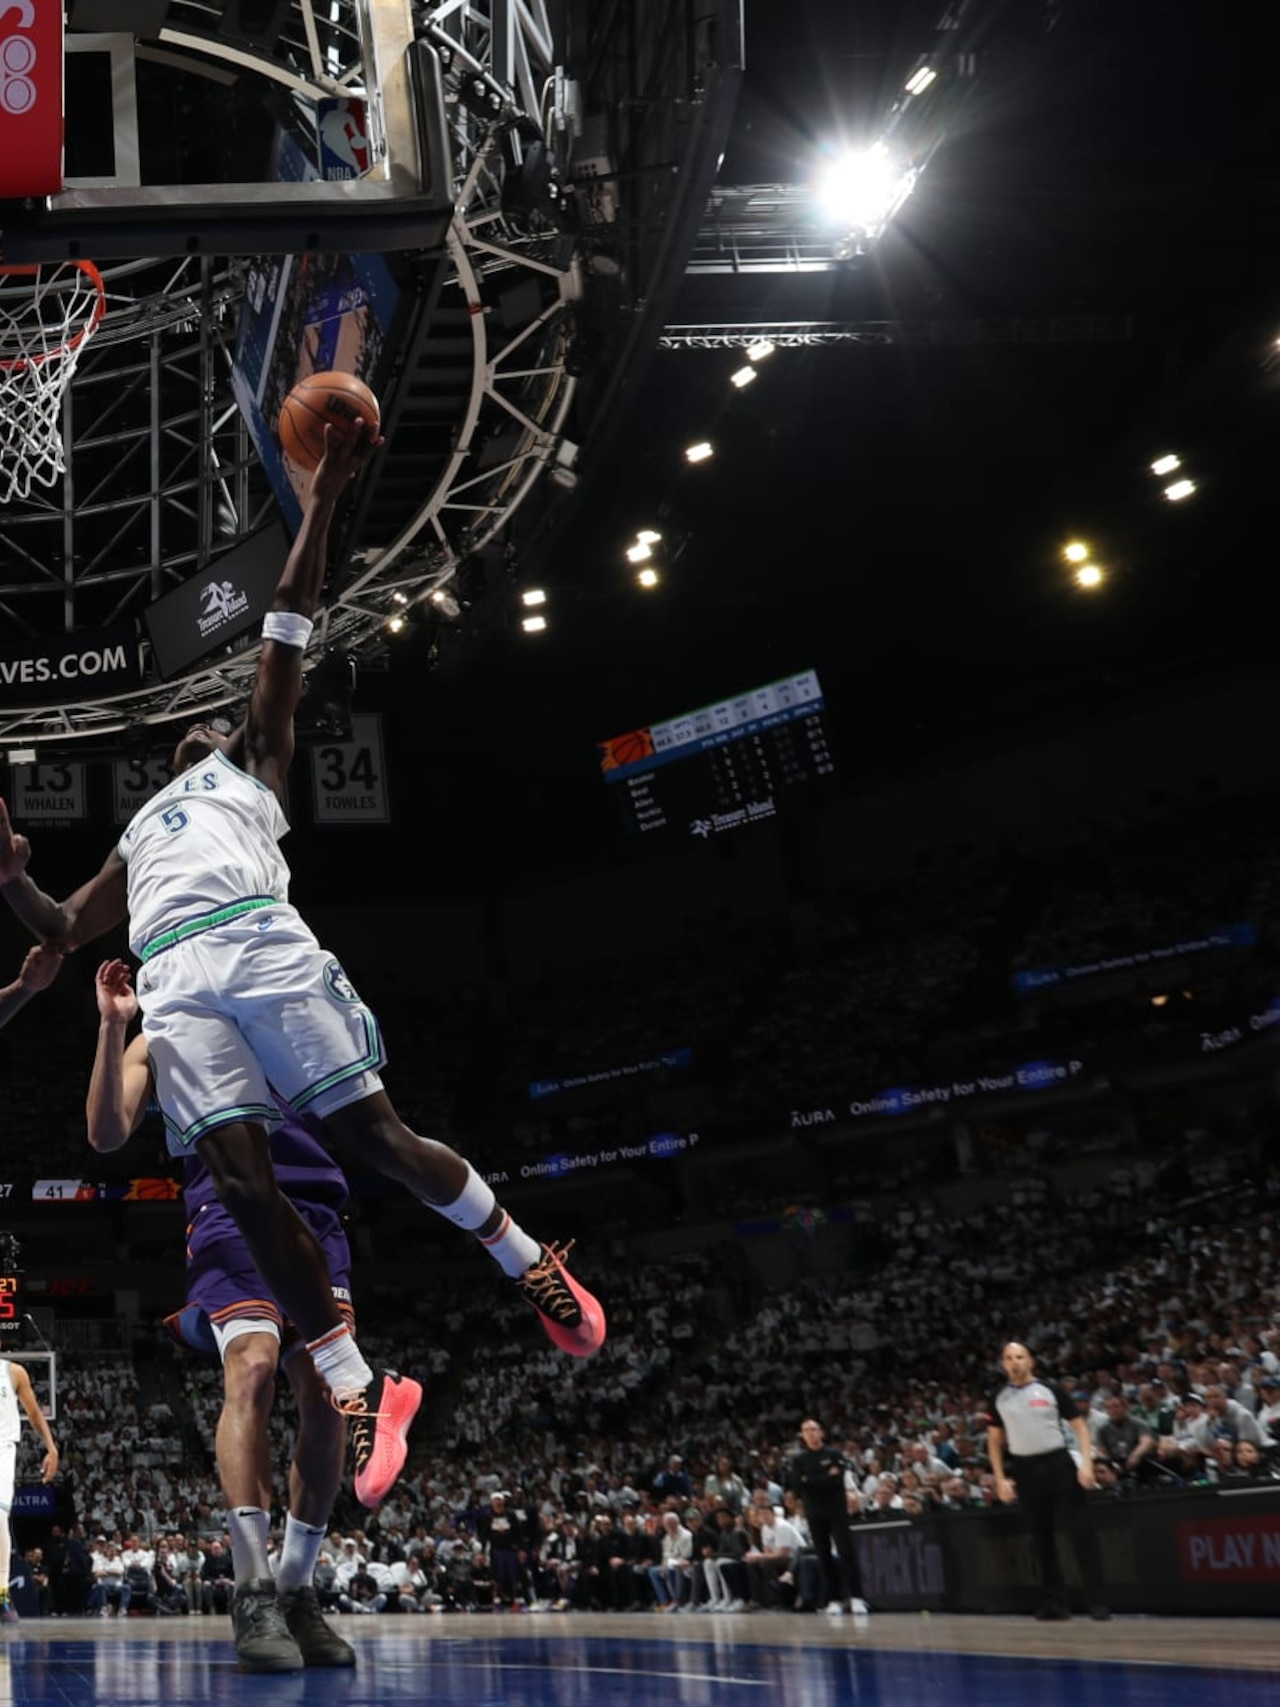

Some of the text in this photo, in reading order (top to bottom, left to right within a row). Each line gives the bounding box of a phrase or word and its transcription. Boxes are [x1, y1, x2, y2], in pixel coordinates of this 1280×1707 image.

[328, 167, 352, 180] NBA
[24, 762, 73, 793] 13
[321, 747, 378, 791] 34
[24, 797, 75, 811] WHALEN
[326, 796, 376, 809] FOWLES
[160, 803, 189, 833] 5
[849, 1097, 899, 1117] Online
[901, 1085, 951, 1107] Safety
[953, 1081, 976, 1098] for
[977, 1075, 1014, 1092] Your
[1016, 1065, 1067, 1086] Entire
[1069, 1059, 1084, 1075] P
[481, 1132, 701, 1187] URA Online Safety for Your Entire P
[46, 1184, 63, 1199] 41
[1188, 1533, 1255, 1571] PLAY
